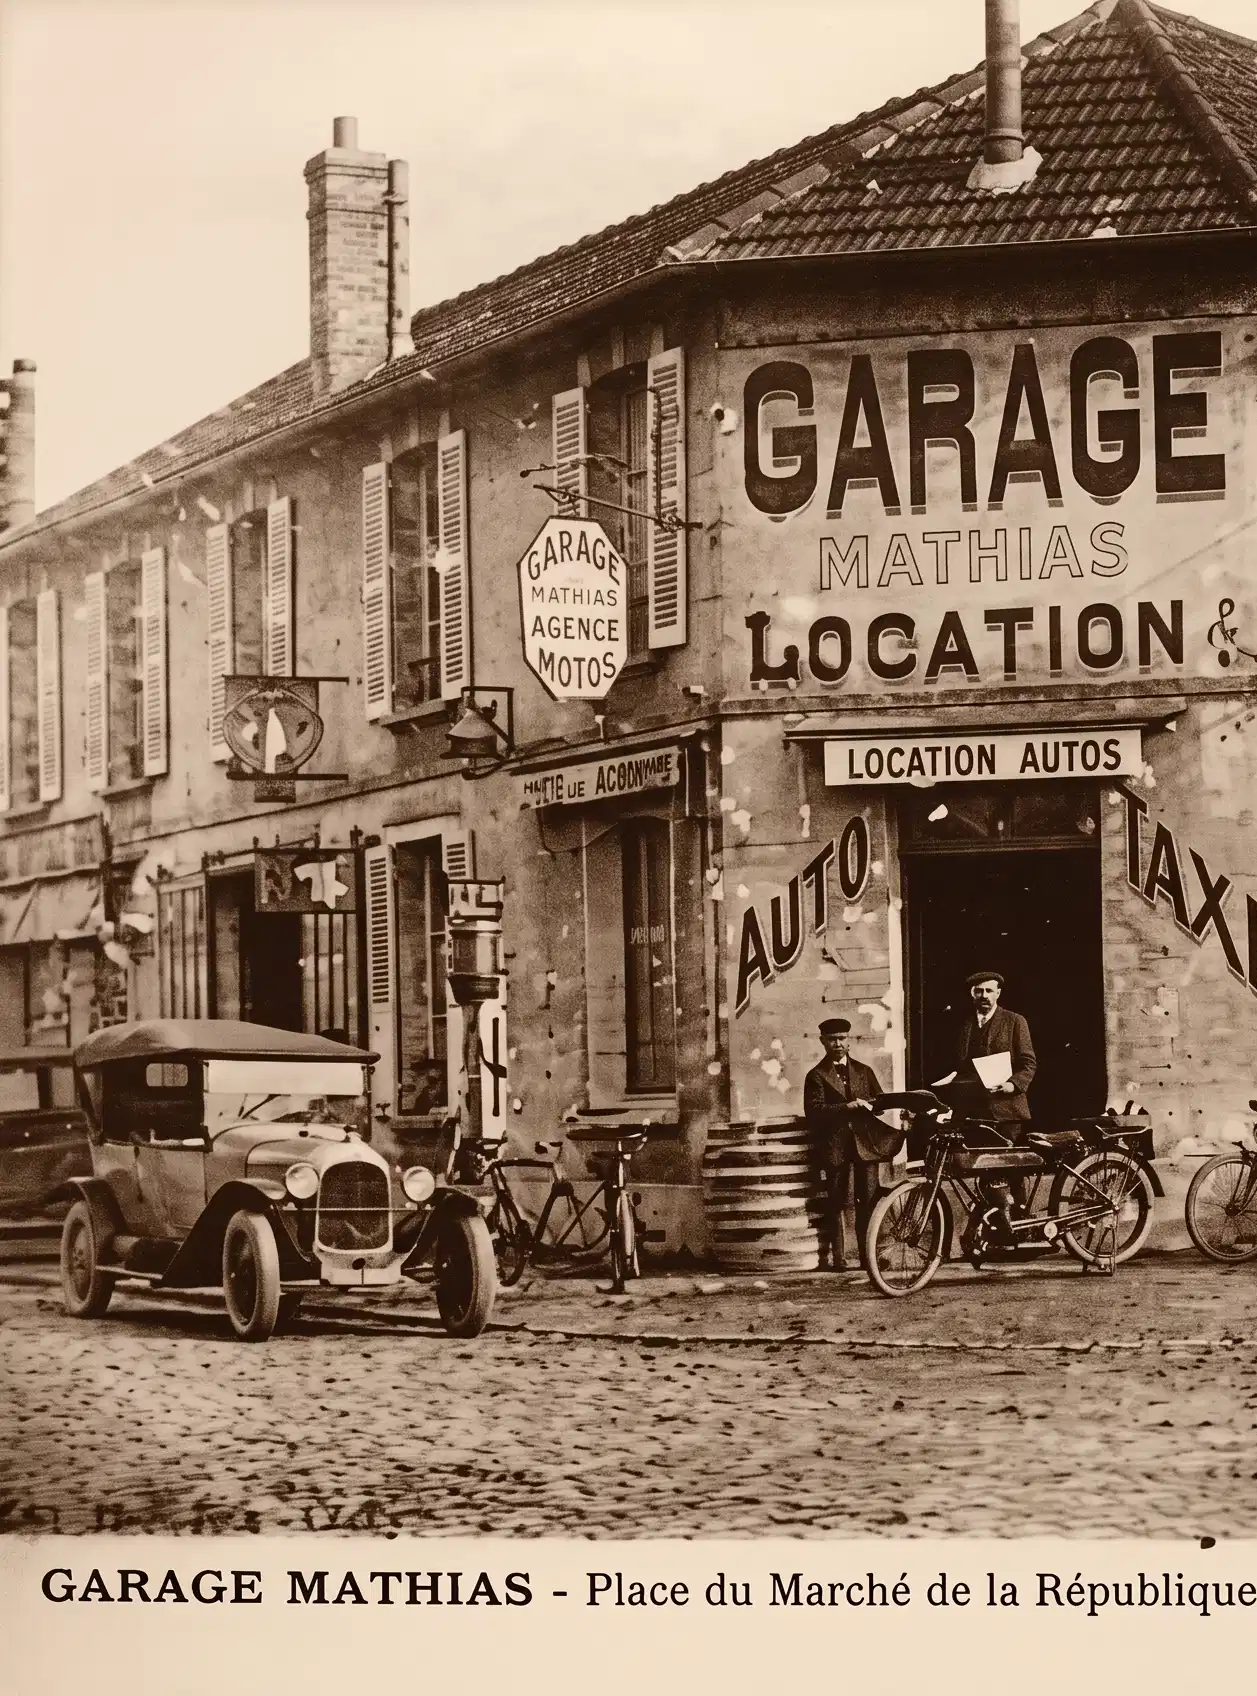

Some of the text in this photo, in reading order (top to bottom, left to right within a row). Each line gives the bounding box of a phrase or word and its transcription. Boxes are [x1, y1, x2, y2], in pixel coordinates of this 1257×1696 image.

[742, 330, 1227, 520] GARAGE
[528, 529, 621, 587] GARAGE
[818, 521, 1130, 591] MATHIAS
[532, 586, 618, 607] MATHIAS
[532, 615, 620, 642] AGENCE
[744, 598, 1186, 692] LOCATION
[538, 646, 617, 690] MOTOS
[847, 738, 1122, 781] LOCATION AUTOS
[734, 814, 872, 1020] AUTO
